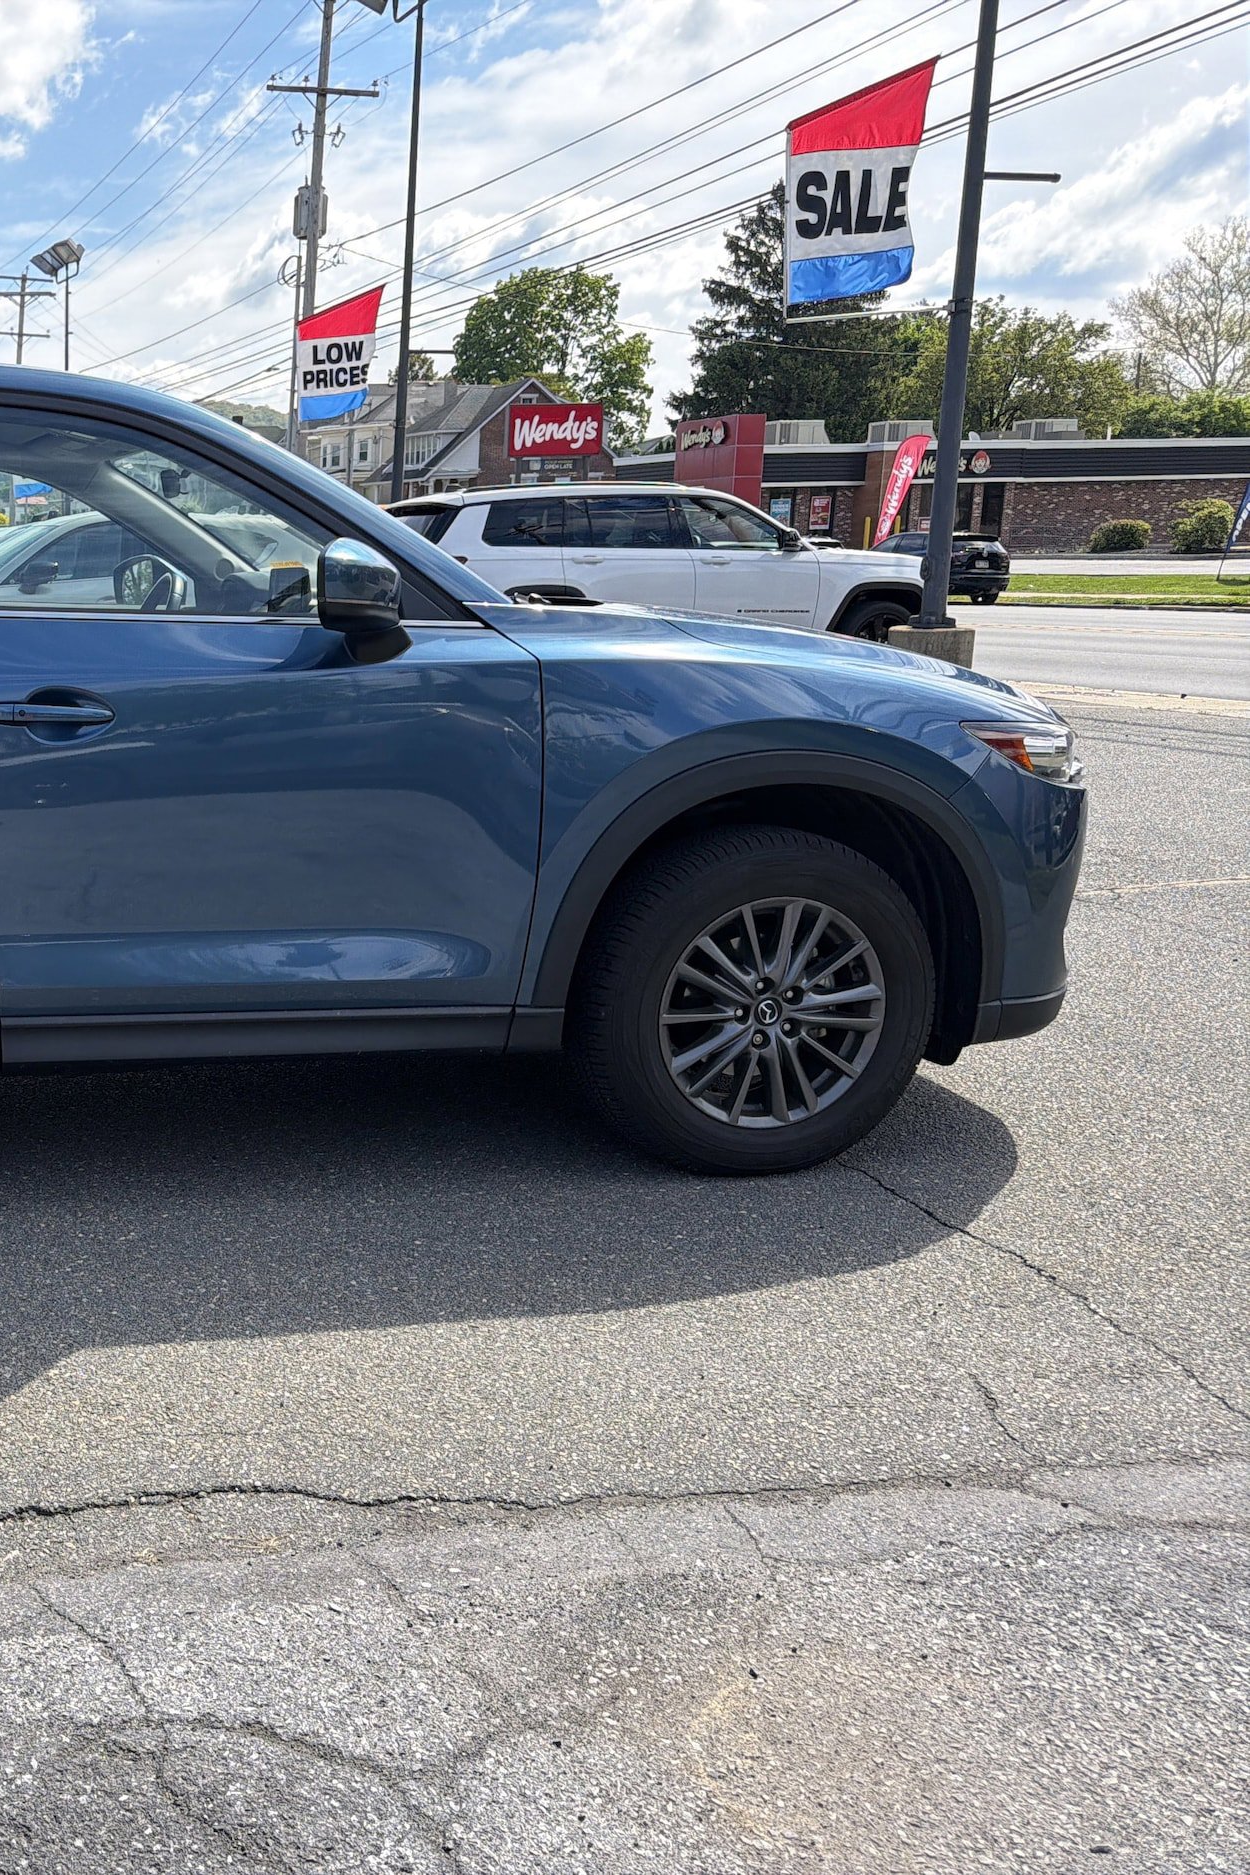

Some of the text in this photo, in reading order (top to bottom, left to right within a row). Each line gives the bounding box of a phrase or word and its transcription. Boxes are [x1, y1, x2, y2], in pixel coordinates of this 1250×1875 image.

[795, 166, 911, 240] SALE
[312, 341, 364, 366] LOW
[303, 363, 369, 391] PRICES
[514, 410, 598, 451] Wendy's
[681, 425, 711, 451] Wendy's
[886, 455, 913, 515] Wendy's
